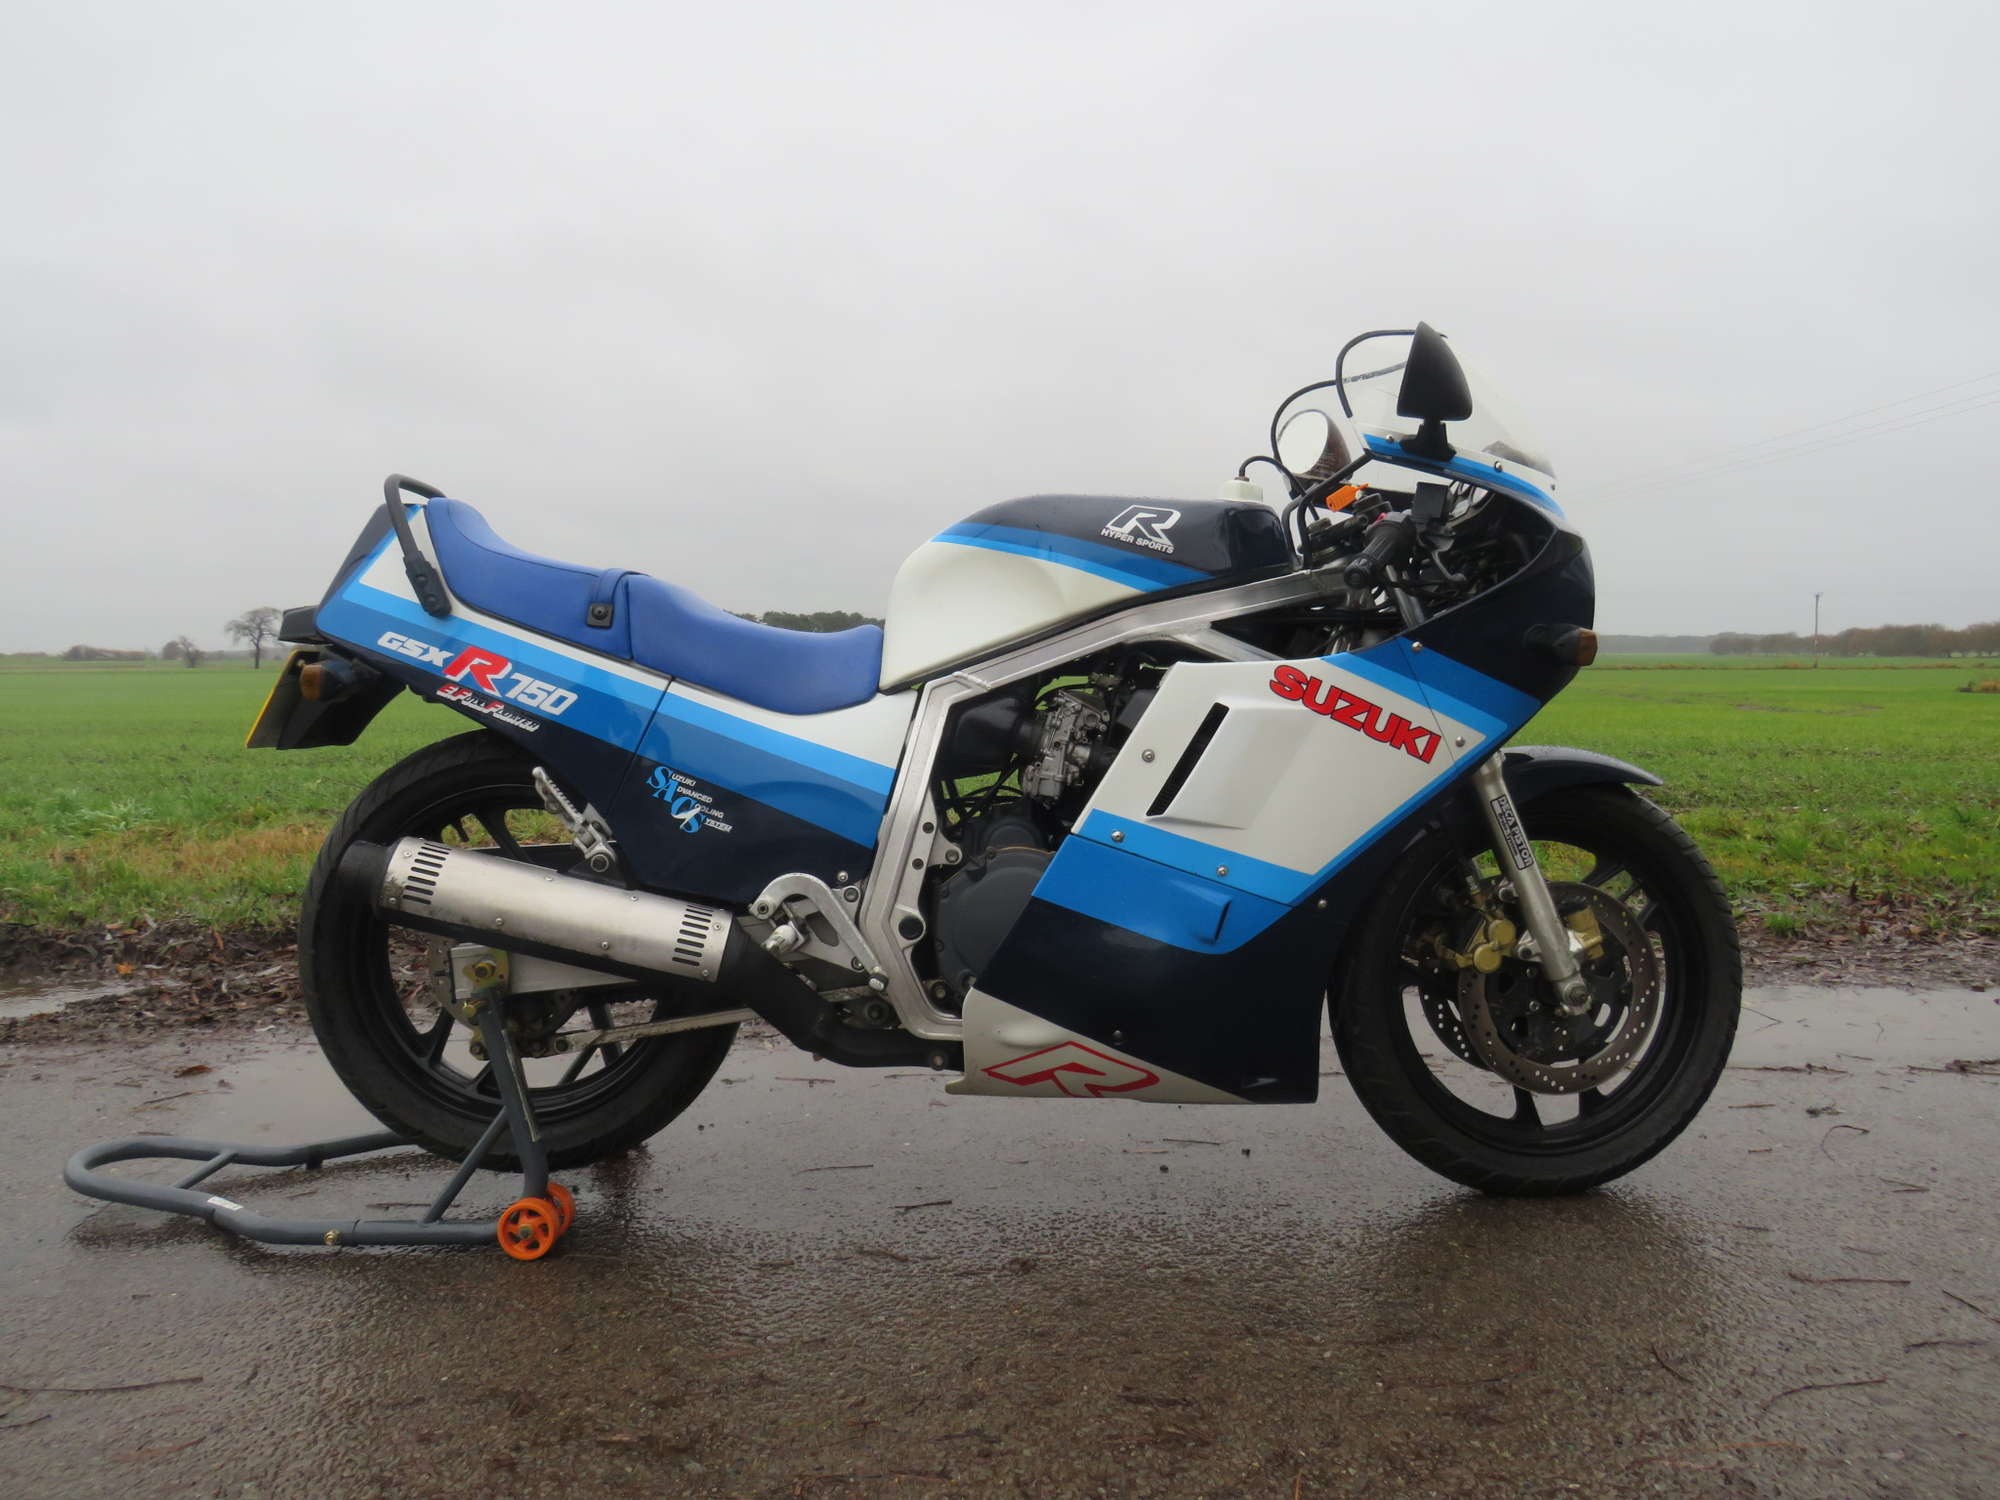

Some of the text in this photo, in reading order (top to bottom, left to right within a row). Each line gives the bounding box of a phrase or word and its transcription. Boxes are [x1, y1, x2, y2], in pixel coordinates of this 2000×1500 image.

[1101, 527, 1175, 554] HYPER SPORTS
[377, 631, 454, 667] GSX
[505, 672, 578, 716] 750
[1269, 664, 1442, 764] SUZUKI
[652, 780, 713, 804] ADVANCED
